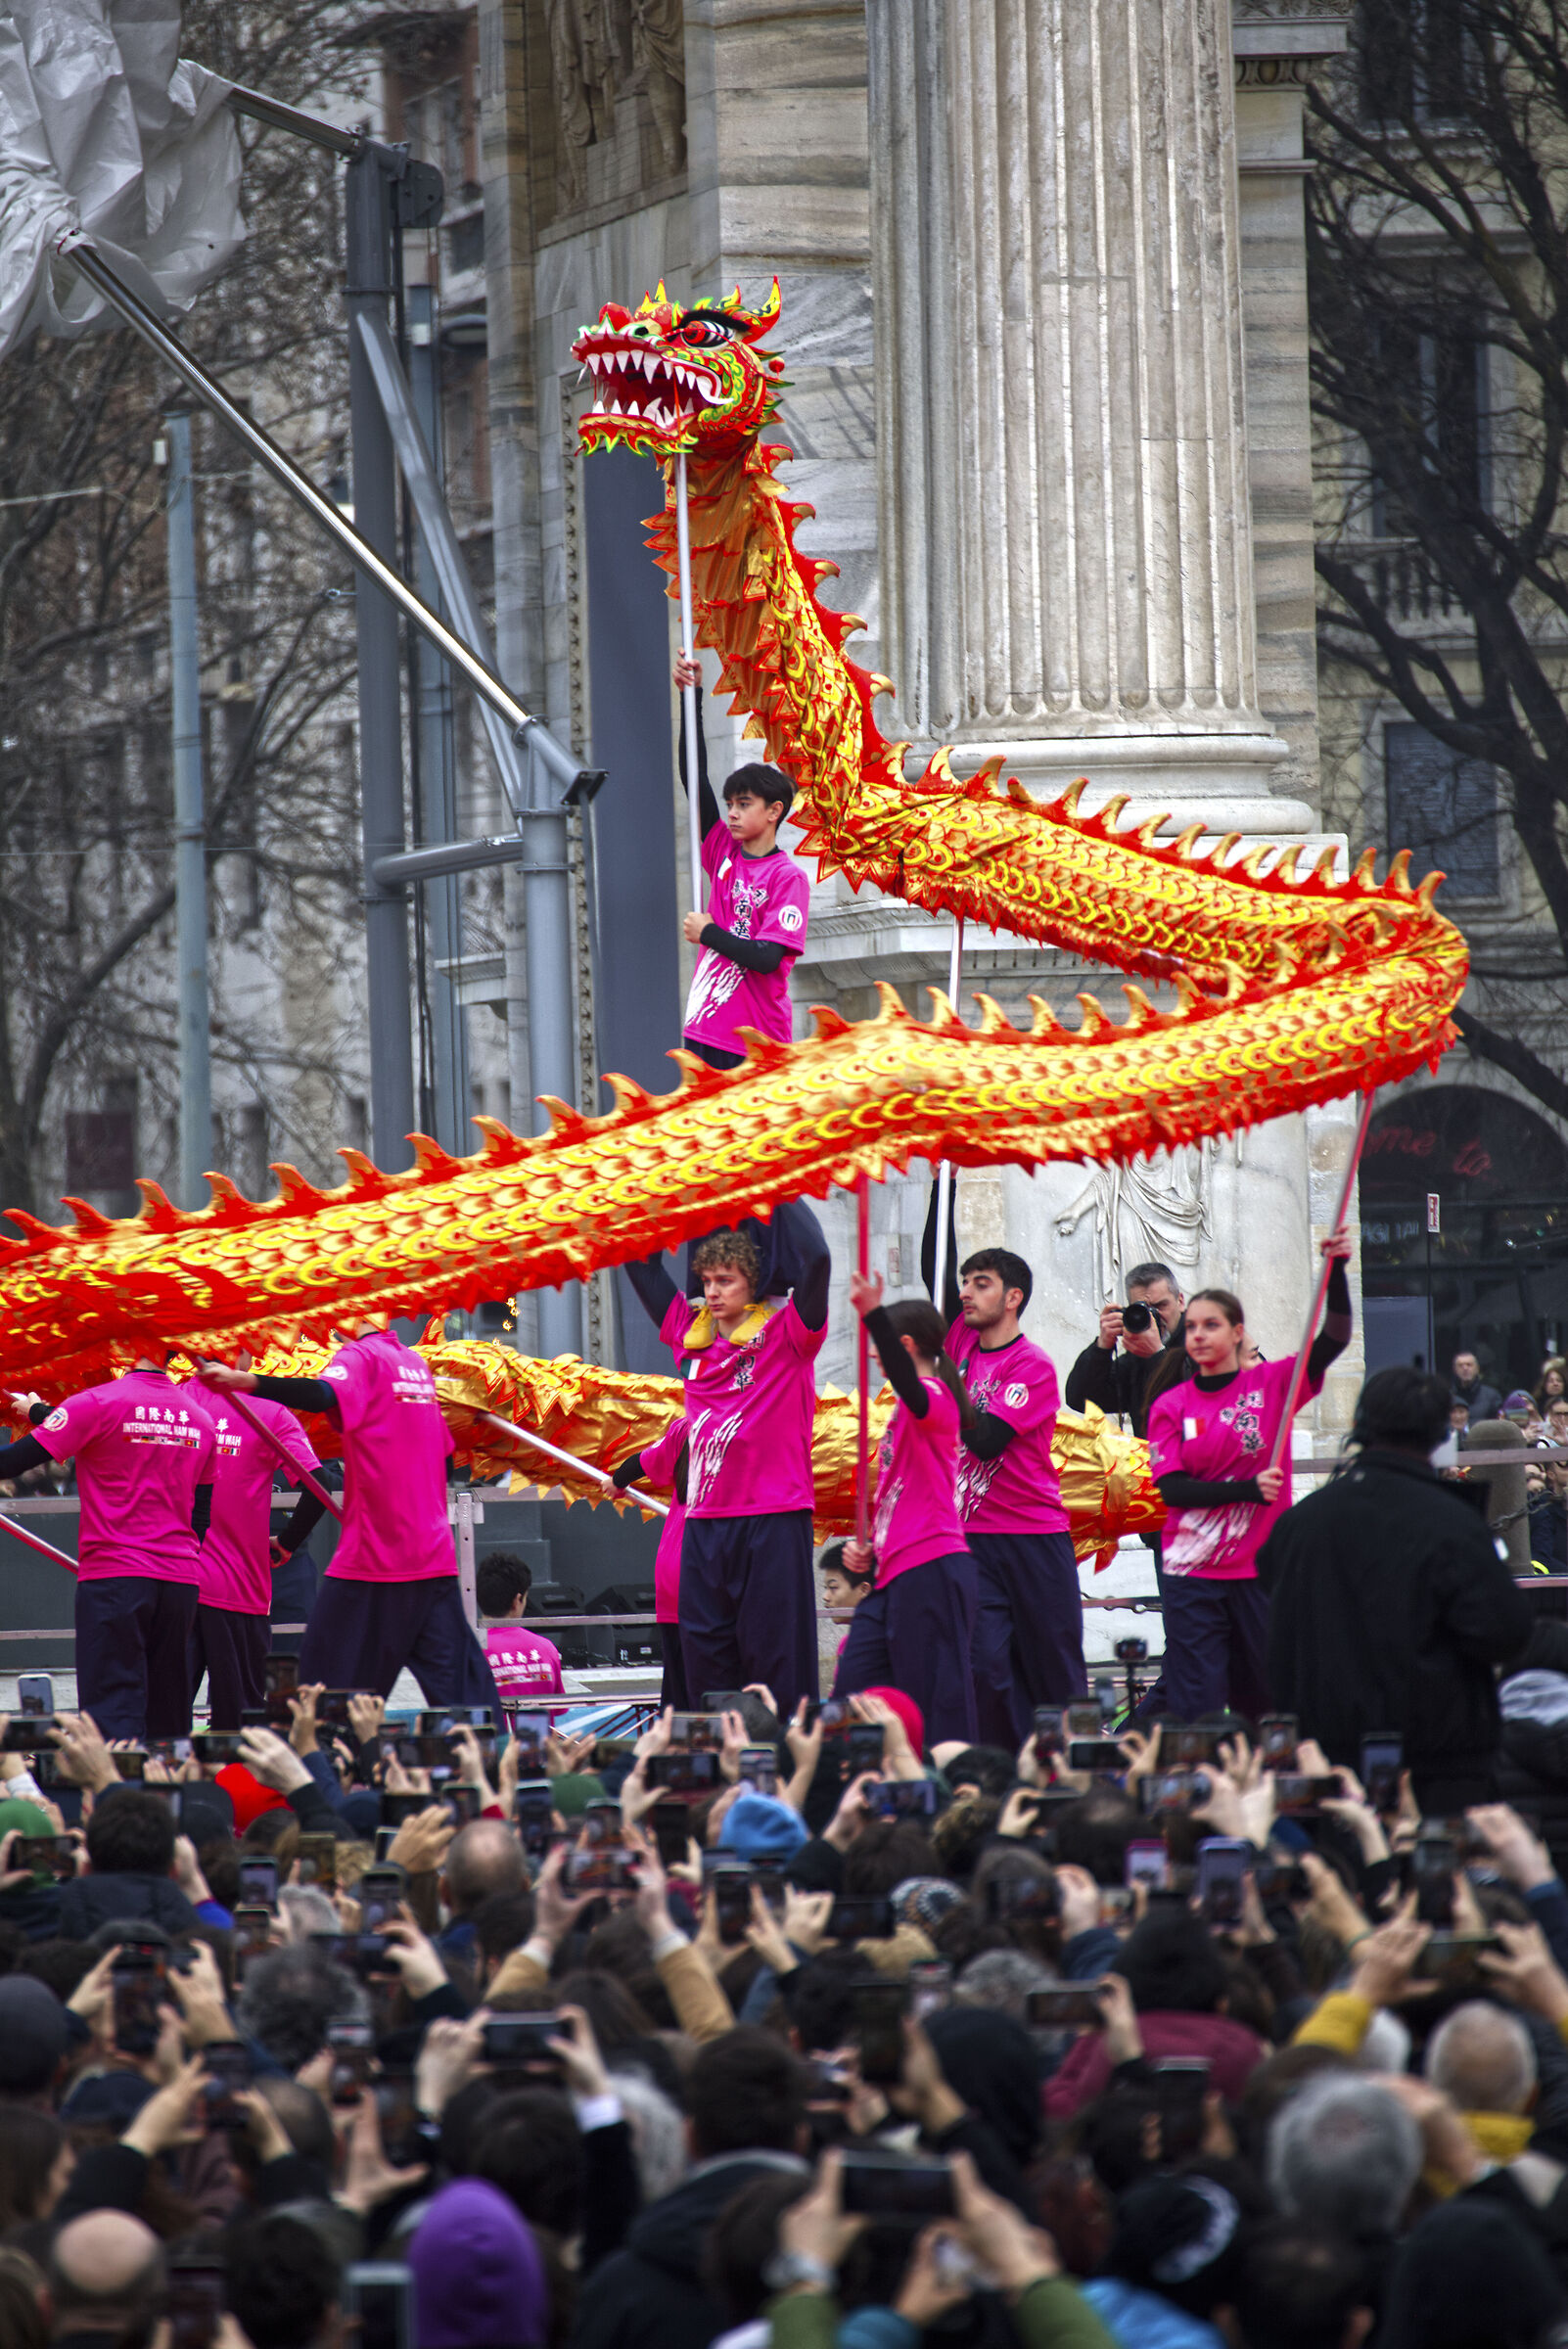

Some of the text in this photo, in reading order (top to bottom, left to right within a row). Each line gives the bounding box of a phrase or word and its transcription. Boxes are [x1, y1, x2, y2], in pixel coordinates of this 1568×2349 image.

[122, 1422, 201, 1441] INTERNATIONAL NAM WAH
[225, 1434, 242, 1447] WAH
